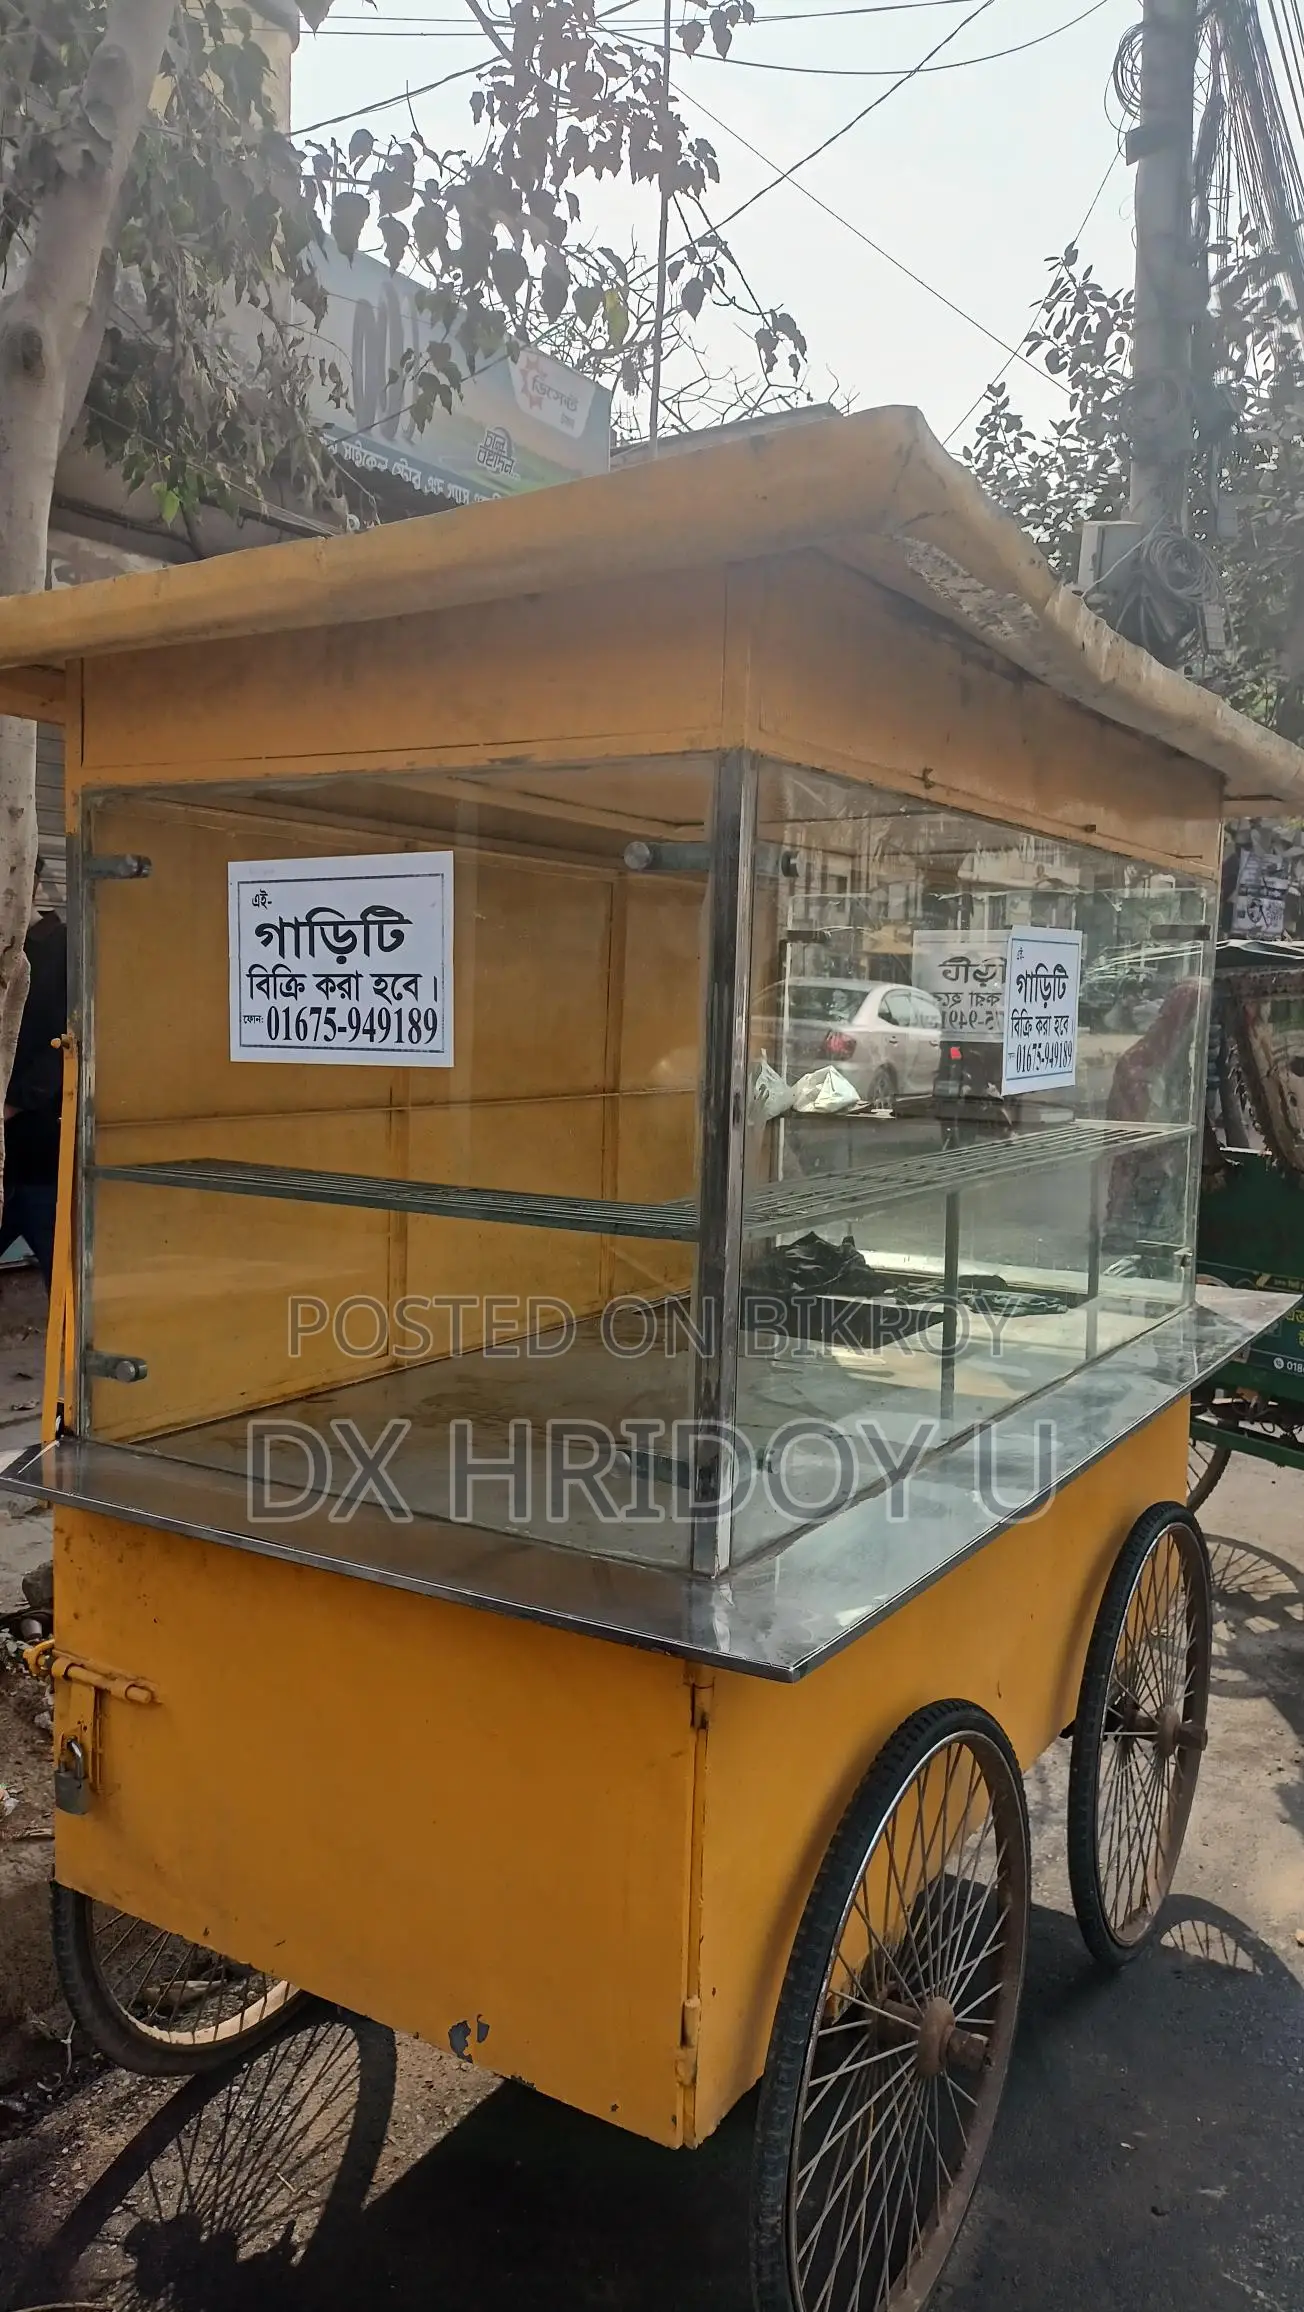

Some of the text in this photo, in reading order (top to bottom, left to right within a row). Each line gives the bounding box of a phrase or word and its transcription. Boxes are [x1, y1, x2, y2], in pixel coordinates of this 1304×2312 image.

[342, 440, 389, 472] সাইকেল
[254, 904, 413, 965] গাড়িটি
[246, 963, 307, 1002] বিক্রি
[312, 970, 364, 1001] করা
[1016, 963, 1069, 1009] গাড়িটি
[266, 1006, 438, 1045] 01675-949189
[1011, 1009, 1033, 1038] বিক্রি
[1035, 1016, 1052, 1036] করা
[1016, 1040, 1073, 1073] 01675-949189
